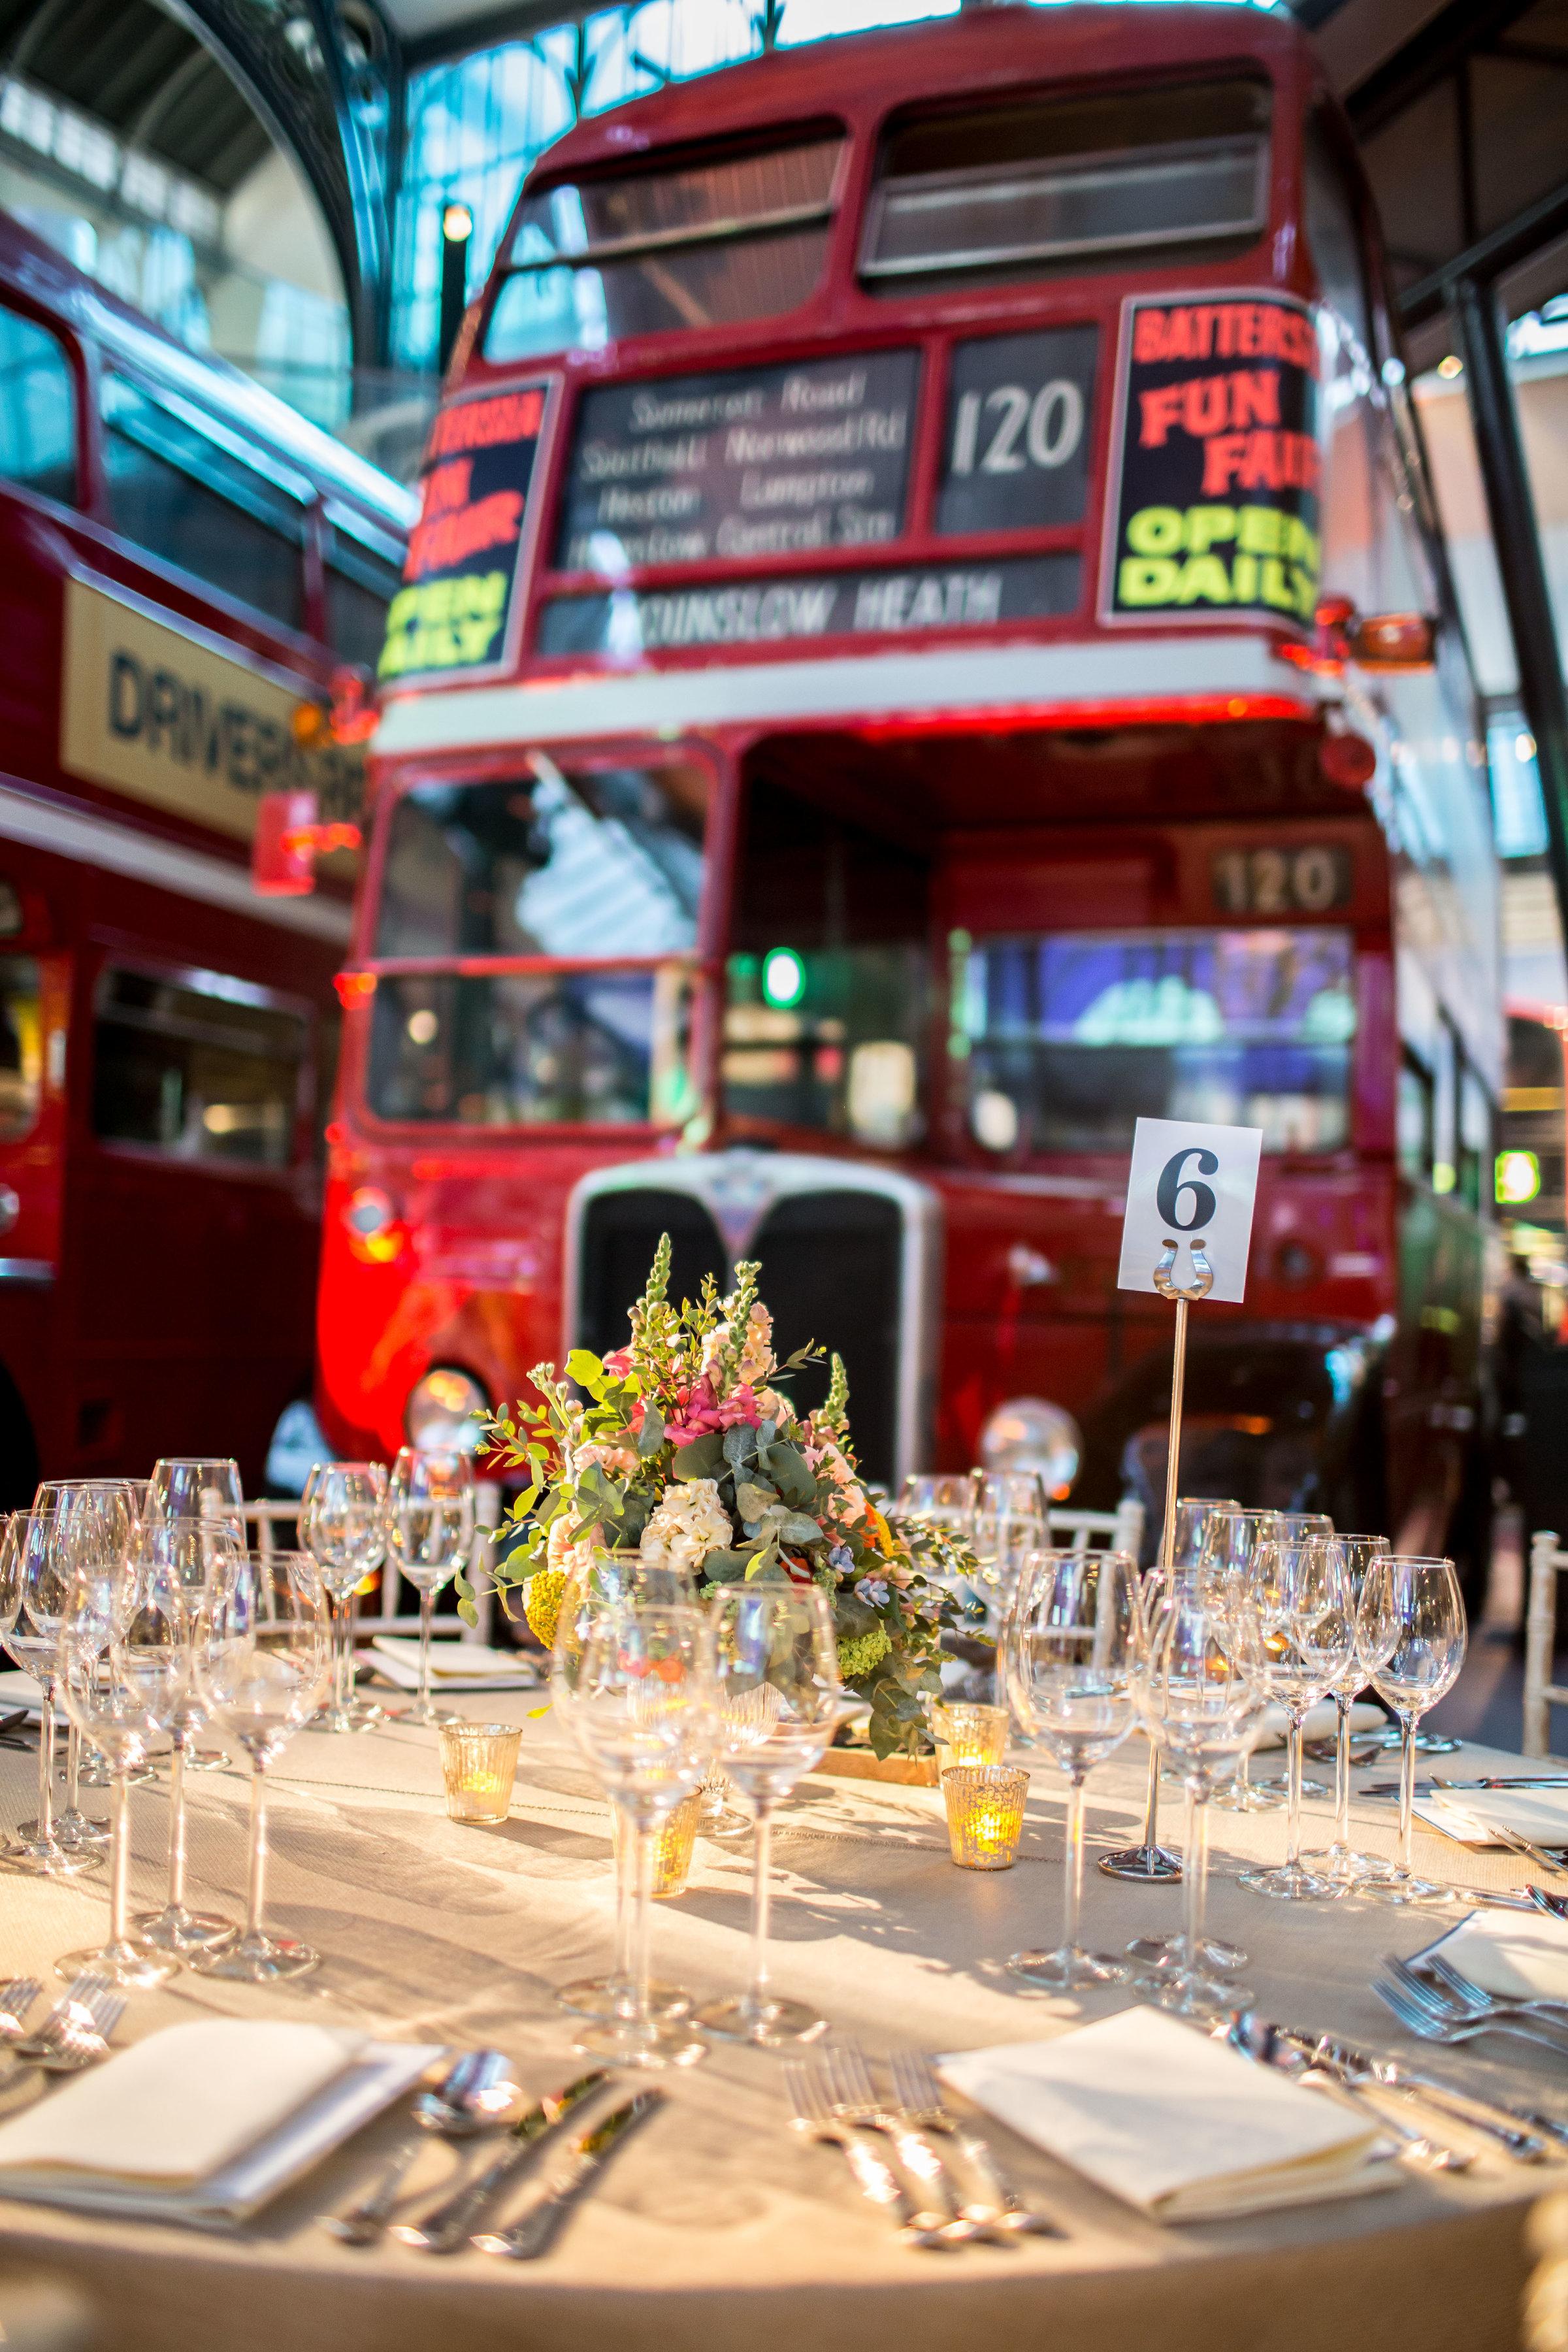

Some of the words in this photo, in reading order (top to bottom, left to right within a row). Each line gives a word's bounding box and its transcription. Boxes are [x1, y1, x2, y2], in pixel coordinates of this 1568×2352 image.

[780, 370, 868, 412] Road
[953, 378, 1084, 476] 120
[1139, 370, 1281, 448] FUN
[611, 583, 837, 651] OUNSLOW
[853, 574, 1004, 630] HEATH
[1213, 848, 1337, 913] 120
[1156, 1148, 1219, 1232] 6
